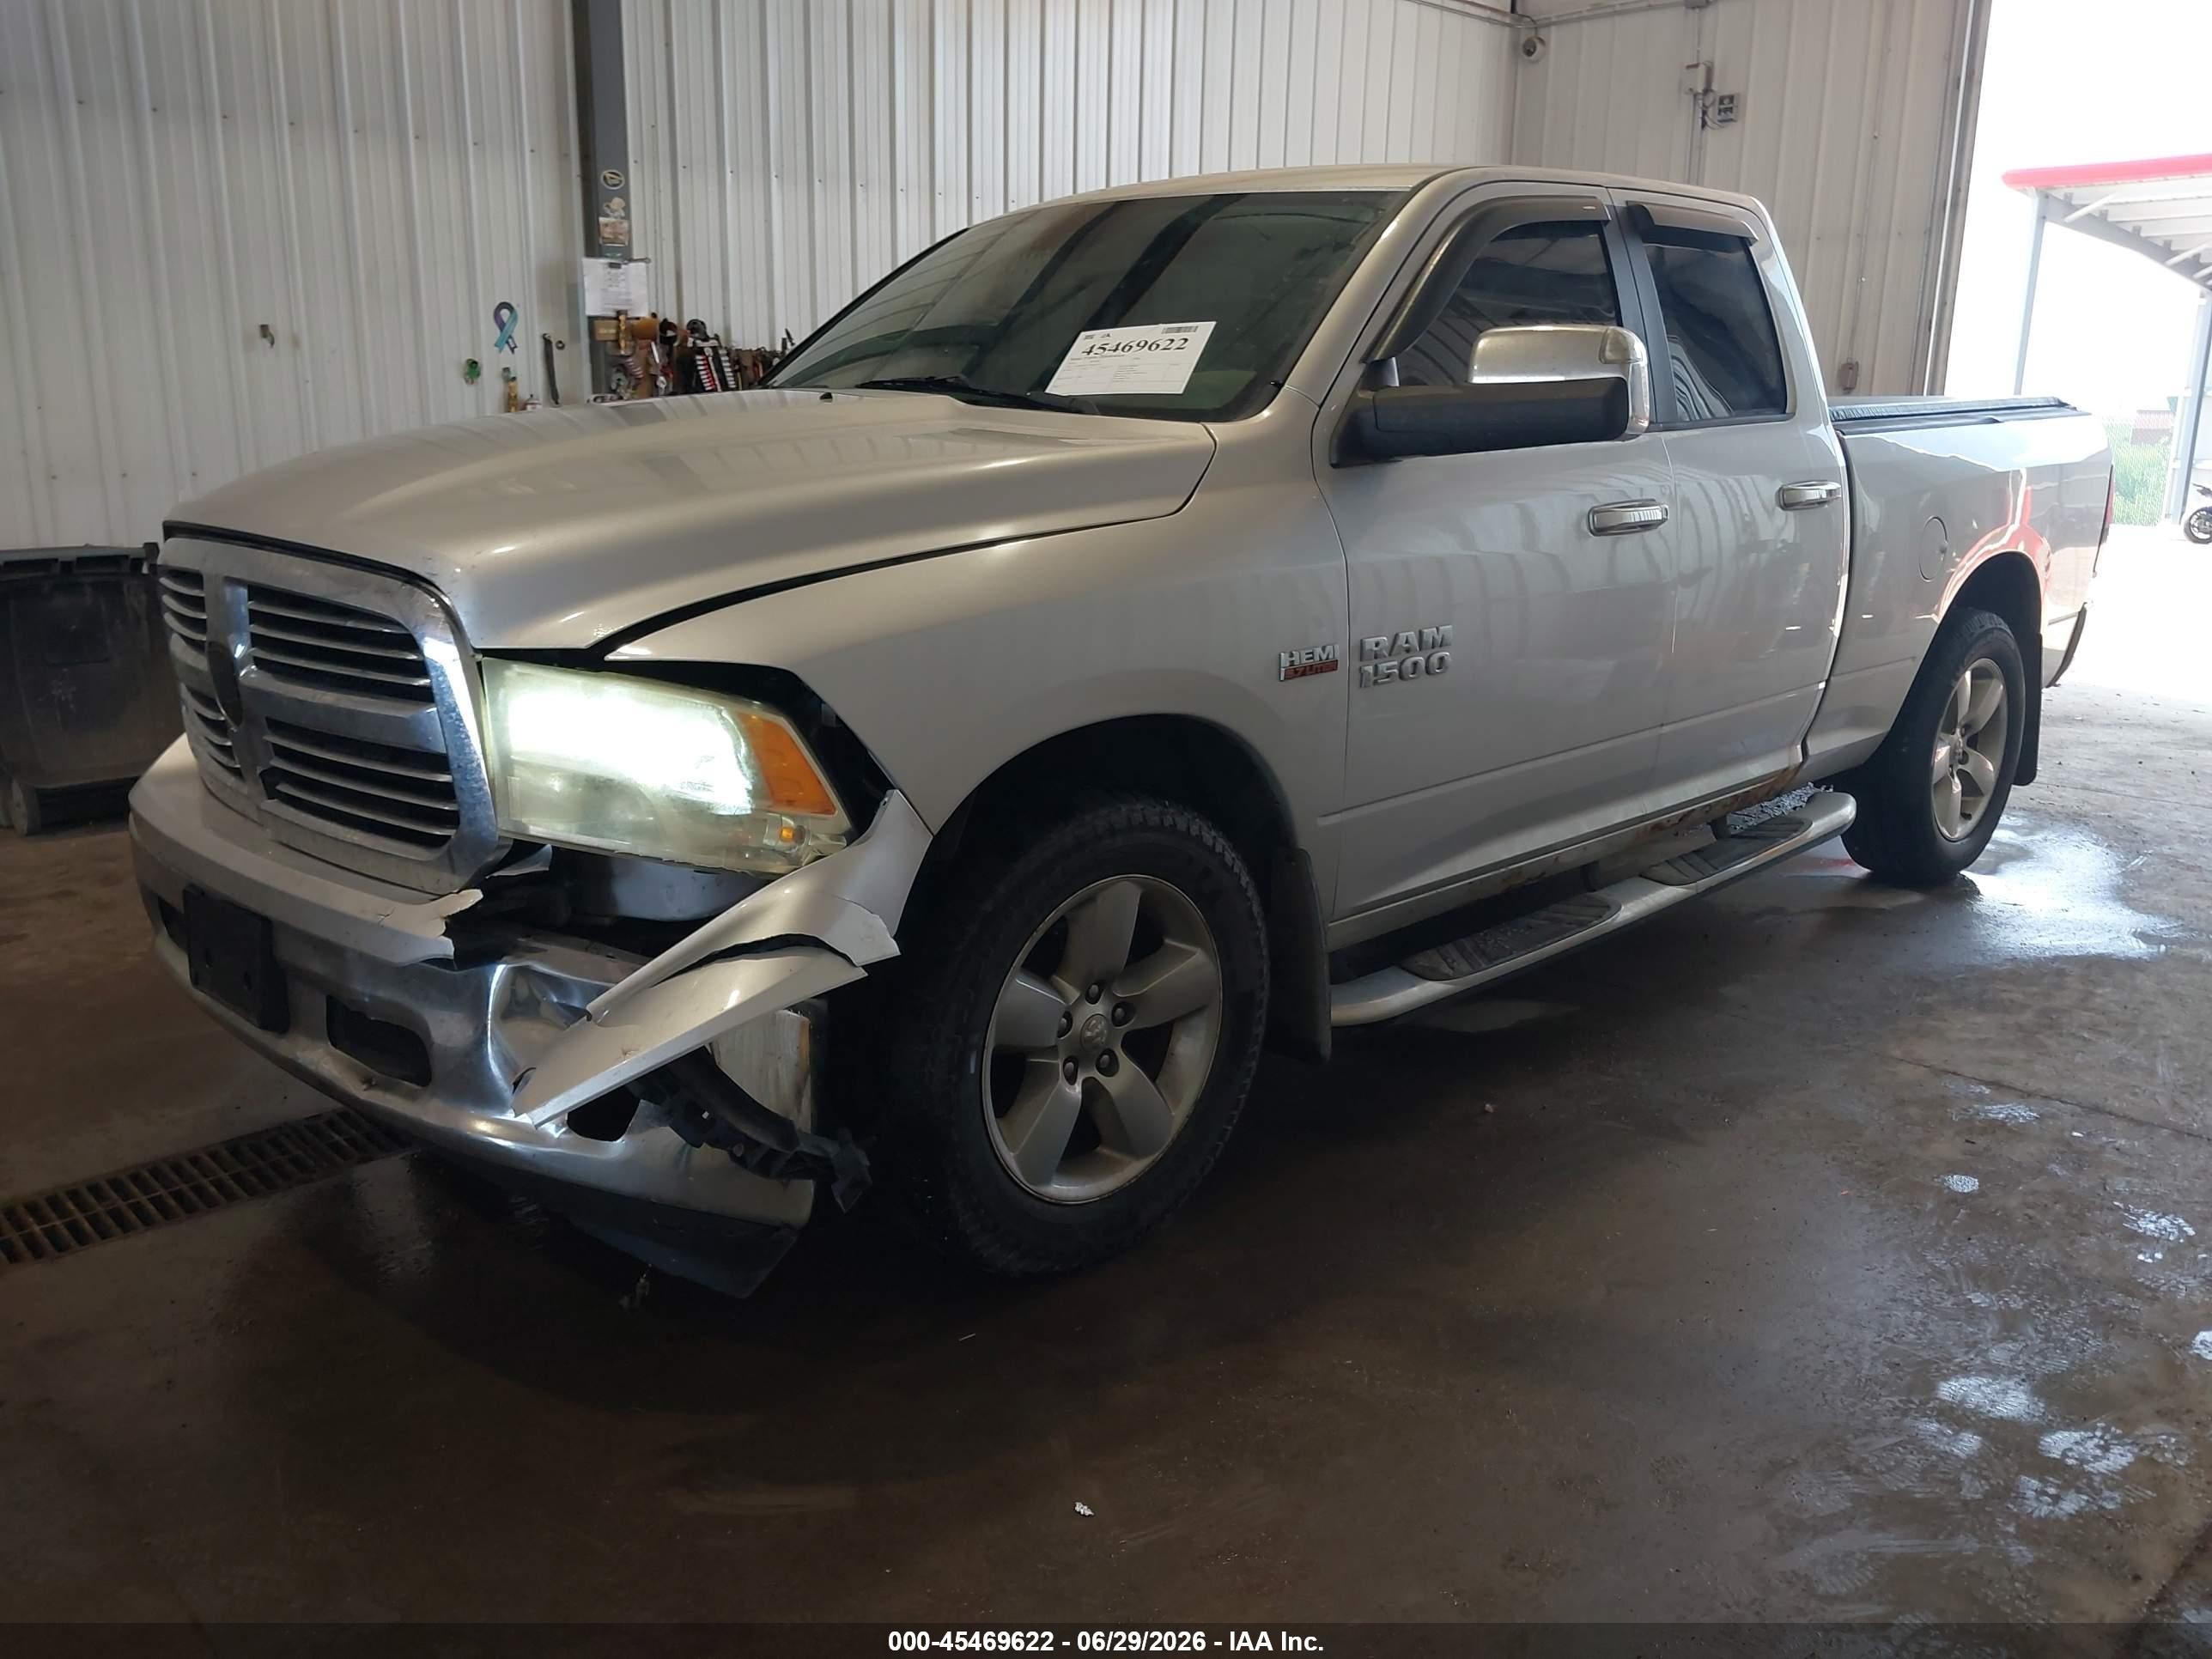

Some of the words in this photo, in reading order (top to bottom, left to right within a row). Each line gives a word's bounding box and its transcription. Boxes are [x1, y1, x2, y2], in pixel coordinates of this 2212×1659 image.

[1081, 337, 1189, 356] 45469622
[1279, 645, 1340, 668] HEMI
[1359, 624, 1453, 661] RAM
[1359, 651, 1451, 688] 1500
